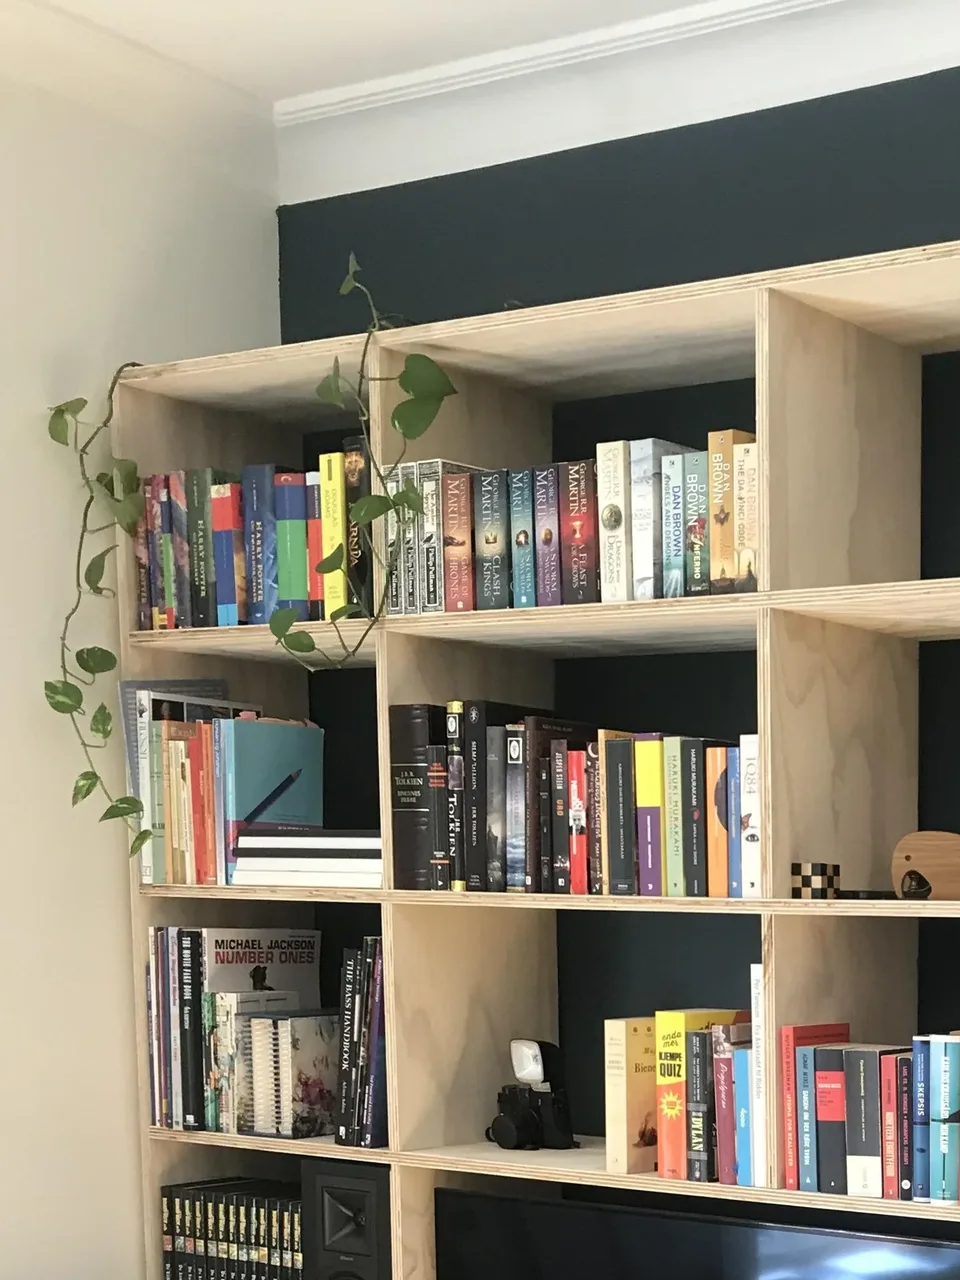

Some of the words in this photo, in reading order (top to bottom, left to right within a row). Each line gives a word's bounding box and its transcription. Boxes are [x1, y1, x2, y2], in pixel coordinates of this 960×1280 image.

[547, 468, 555, 503] GEORGE
[602, 449, 612, 501] MARTIN
[712, 453, 723, 503] BROWN
[722, 463, 730, 491] DAN
[738, 479, 745, 491] DA
[746, 468, 756, 492] DAN
[460, 478, 468, 512] GEORGE
[481, 477, 493, 532] MARTIN
[492, 474, 500, 508] GEORGE
[535, 470, 547, 525] MARTIN
[568, 465, 579, 517] MARTIN
[672, 486, 681, 514] DAN
[686, 474, 699, 526] BROWN
[698, 485, 707, 513] DAN
[447, 480, 460, 537] MARTIN
[746, 496, 756, 541] BROWN
[197, 520, 205, 557] HARRY
[673, 513, 682, 557] BROWN
[738, 523, 746, 547] CODE
[571, 560, 579, 588] CROWS
[607, 536, 616, 584] DRAGONS
[450, 551, 459, 599] THRONES
[484, 563, 492, 597] KINGS
[493, 555, 501, 595] CLASH
[555, 753, 563, 774] JESPER
[395, 777, 423, 785] TOLKIEN
[448, 794, 457, 857] TOLKIEN
[182, 937, 191, 948] THE
[215, 939, 263, 950] MICHAEL
[267, 940, 315, 950] JACKSON
[215, 951, 274, 964] NUMBER
[279, 952, 315, 964] ONES
[346, 959, 354, 982] THE
[184, 985, 192, 1000] BOOK
[344, 984, 353, 1009] BASS
[342, 1010, 352, 1071] HANDBOOK
[662, 1030, 682, 1041] enda
[663, 1039, 678, 1048] mer
[634, 1062, 656, 1073] Biene
[659, 1052, 682, 1062] KJEMPE
[660, 1063, 682, 1078] QUIZ
[691, 1117, 703, 1151] DYLAN
[885, 1111, 894, 1139] NINETEEN
